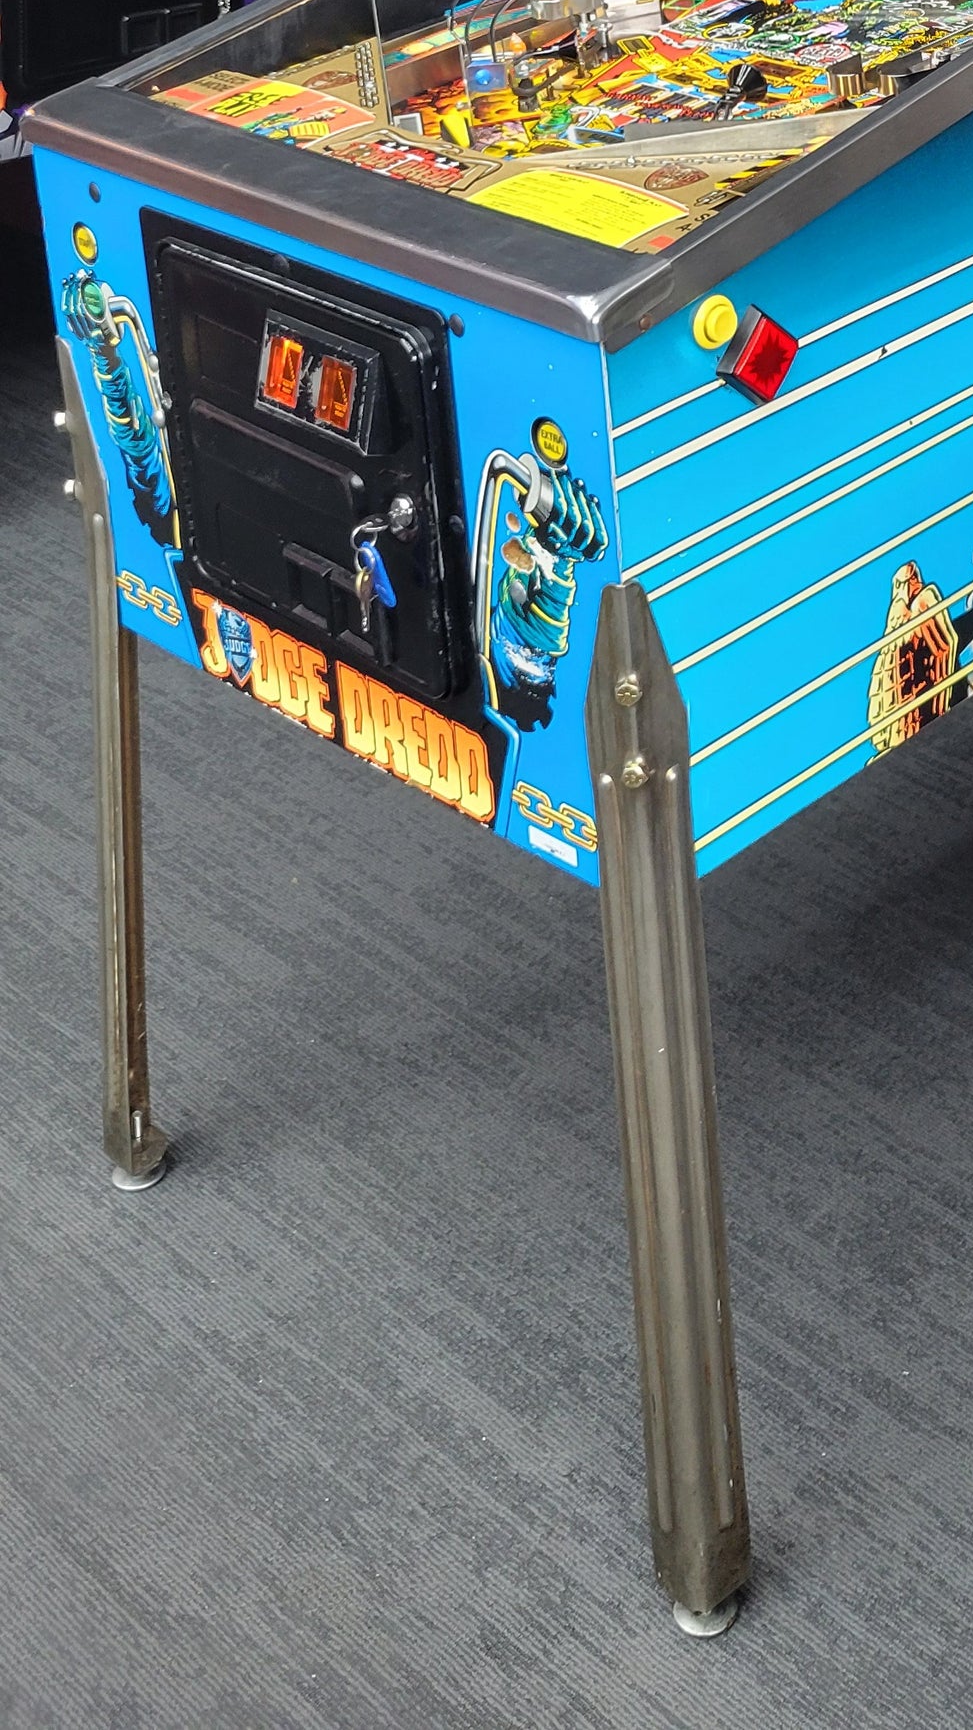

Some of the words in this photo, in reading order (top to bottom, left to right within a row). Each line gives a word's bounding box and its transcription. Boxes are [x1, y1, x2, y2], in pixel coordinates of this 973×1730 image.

[543, 440, 561, 455] BALL
[192, 587, 337, 740] JUDGE
[335, 659, 496, 824] DREDD
